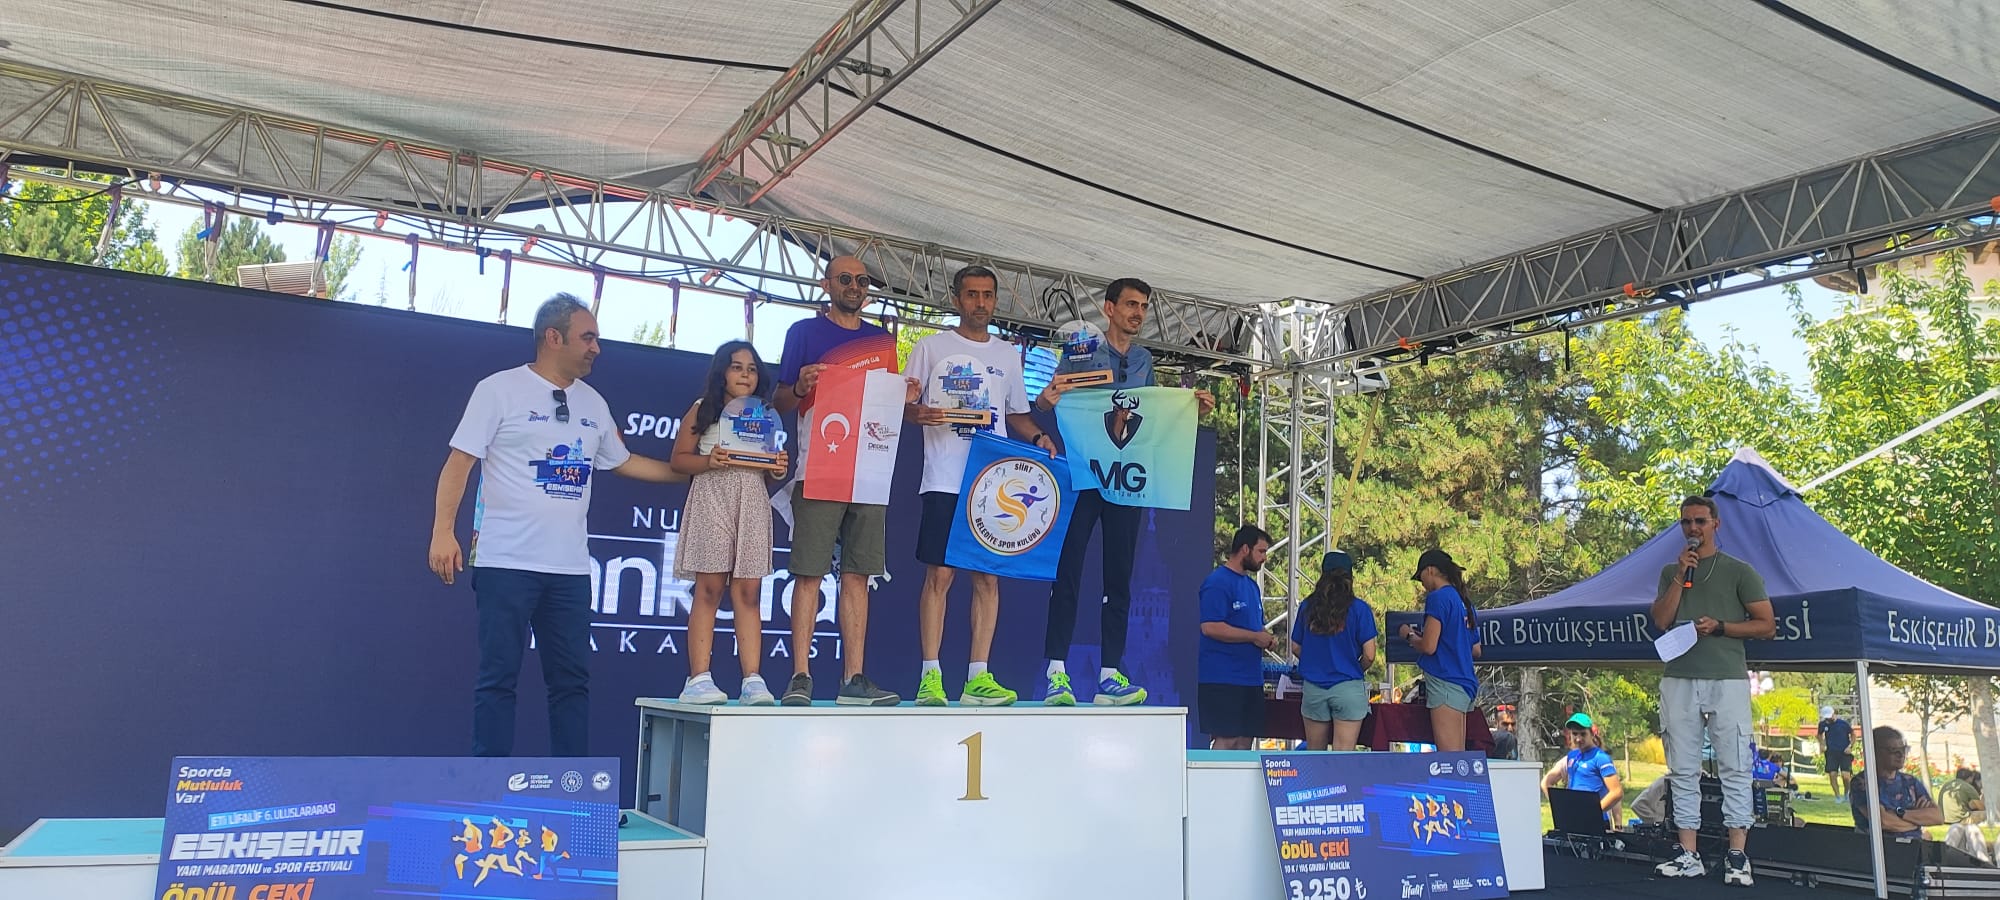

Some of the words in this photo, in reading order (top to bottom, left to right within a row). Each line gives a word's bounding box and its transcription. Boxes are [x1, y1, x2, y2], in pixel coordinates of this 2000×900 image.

[1014, 462, 1033, 473] SİİRT
[1090, 459, 1146, 492] MG
[975, 517, 998, 545] BELEDİYE
[1017, 528, 1041, 547] KULÜBÜ
[1513, 613, 1654, 647] BÜYÜKŞEHİR
[1887, 610, 1977, 650] ESKİŞEHİR
[178, 766, 232, 779] Sporda
[957, 731, 989, 801] 1
[1265, 759, 1290, 768] Sporda
[176, 780, 244, 791] Mutluluk
[1268, 778, 1282, 786] Var!
[175, 792, 205, 804] Var!
[1275, 804, 1365, 825] ESKİŞEHİR
[169, 830, 364, 860] ESKİŞEHİR
[1281, 840, 1317, 859] ÖDÜL
[1320, 838, 1349, 860] ÇEKİ
[176, 864, 202, 877] YARI
[203, 863, 263, 876] MARATONU
[263, 866, 272, 874] ve
[273, 862, 301, 874] SPOR
[1290, 877, 1351, 900] 3.250
[1476, 878, 1492, 887] TCL
